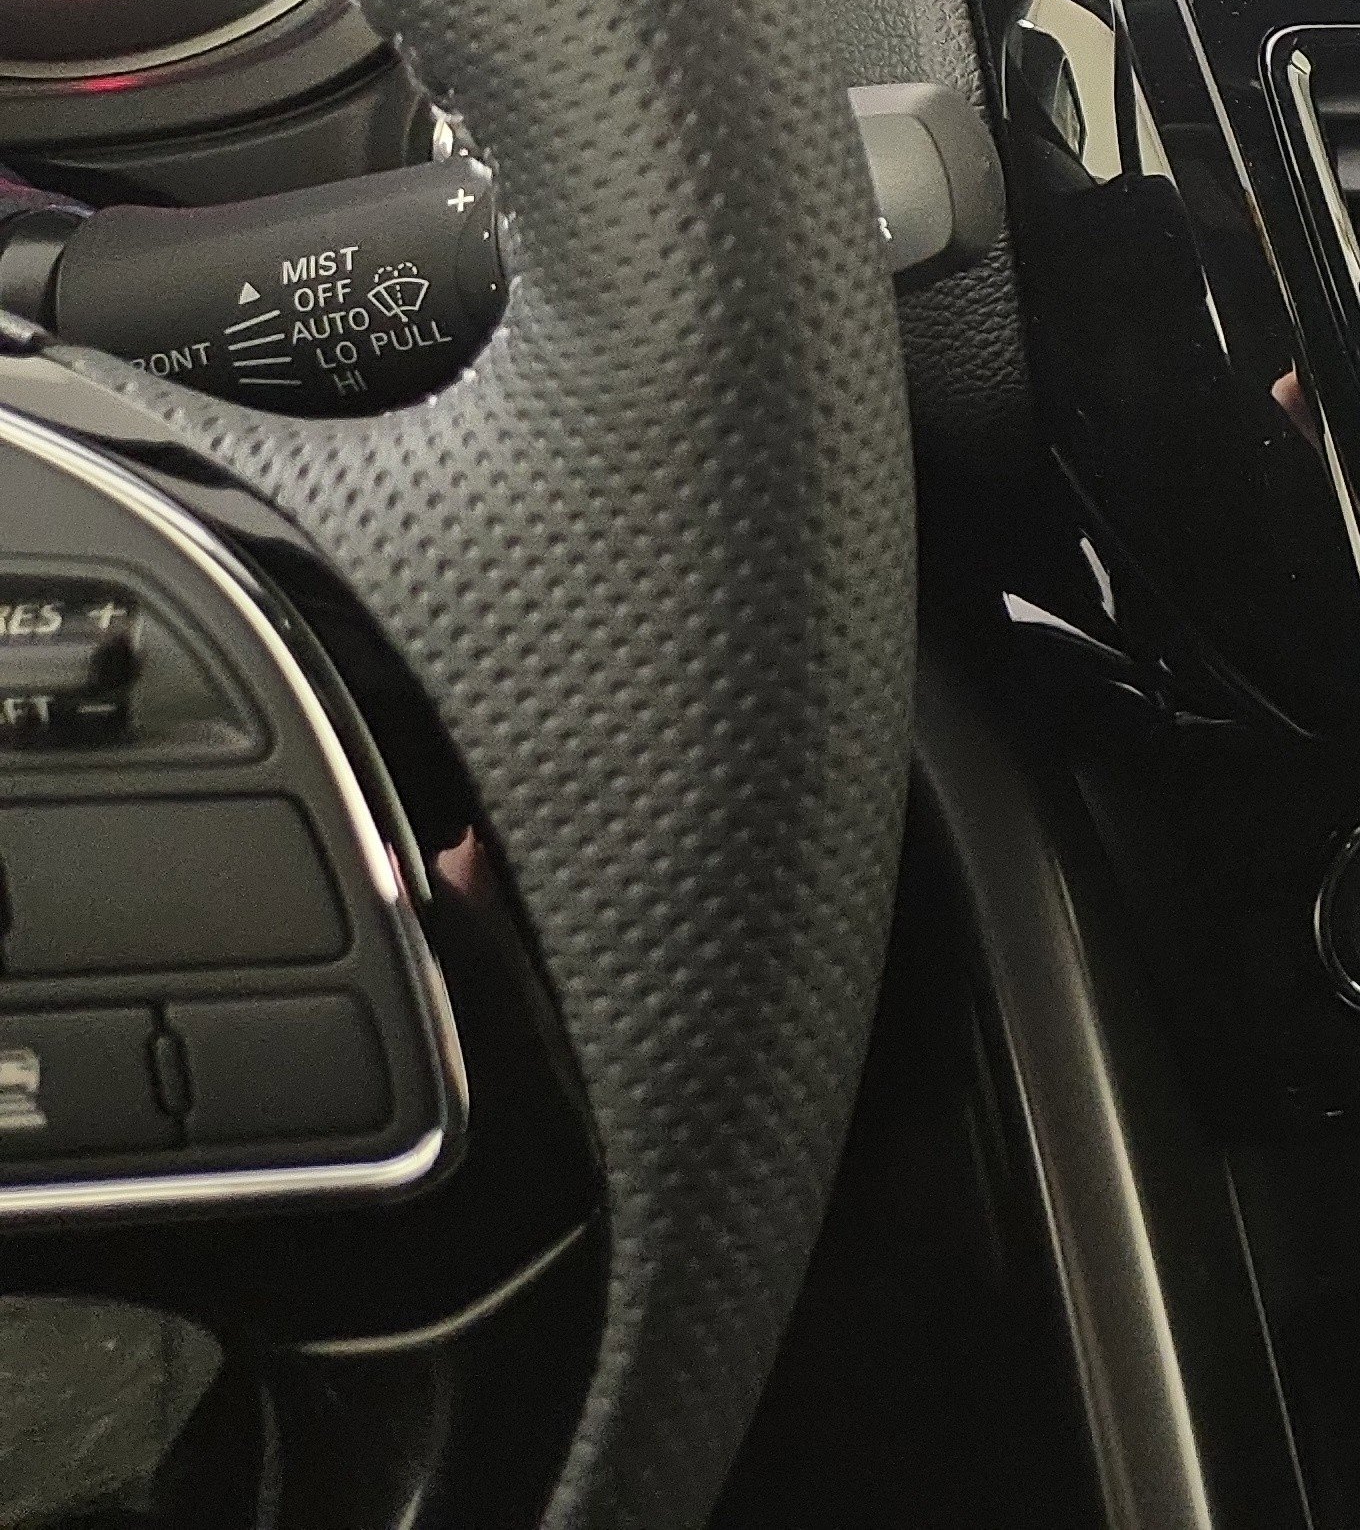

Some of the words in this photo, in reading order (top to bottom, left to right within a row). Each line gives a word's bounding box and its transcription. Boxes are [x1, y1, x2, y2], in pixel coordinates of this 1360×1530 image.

[281, 246, 359, 285] MIST
[294, 279, 352, 312] OFF
[292, 307, 370, 345] AUTO
[370, 320, 452, 356] PULL
[315, 341, 358, 369] LO
